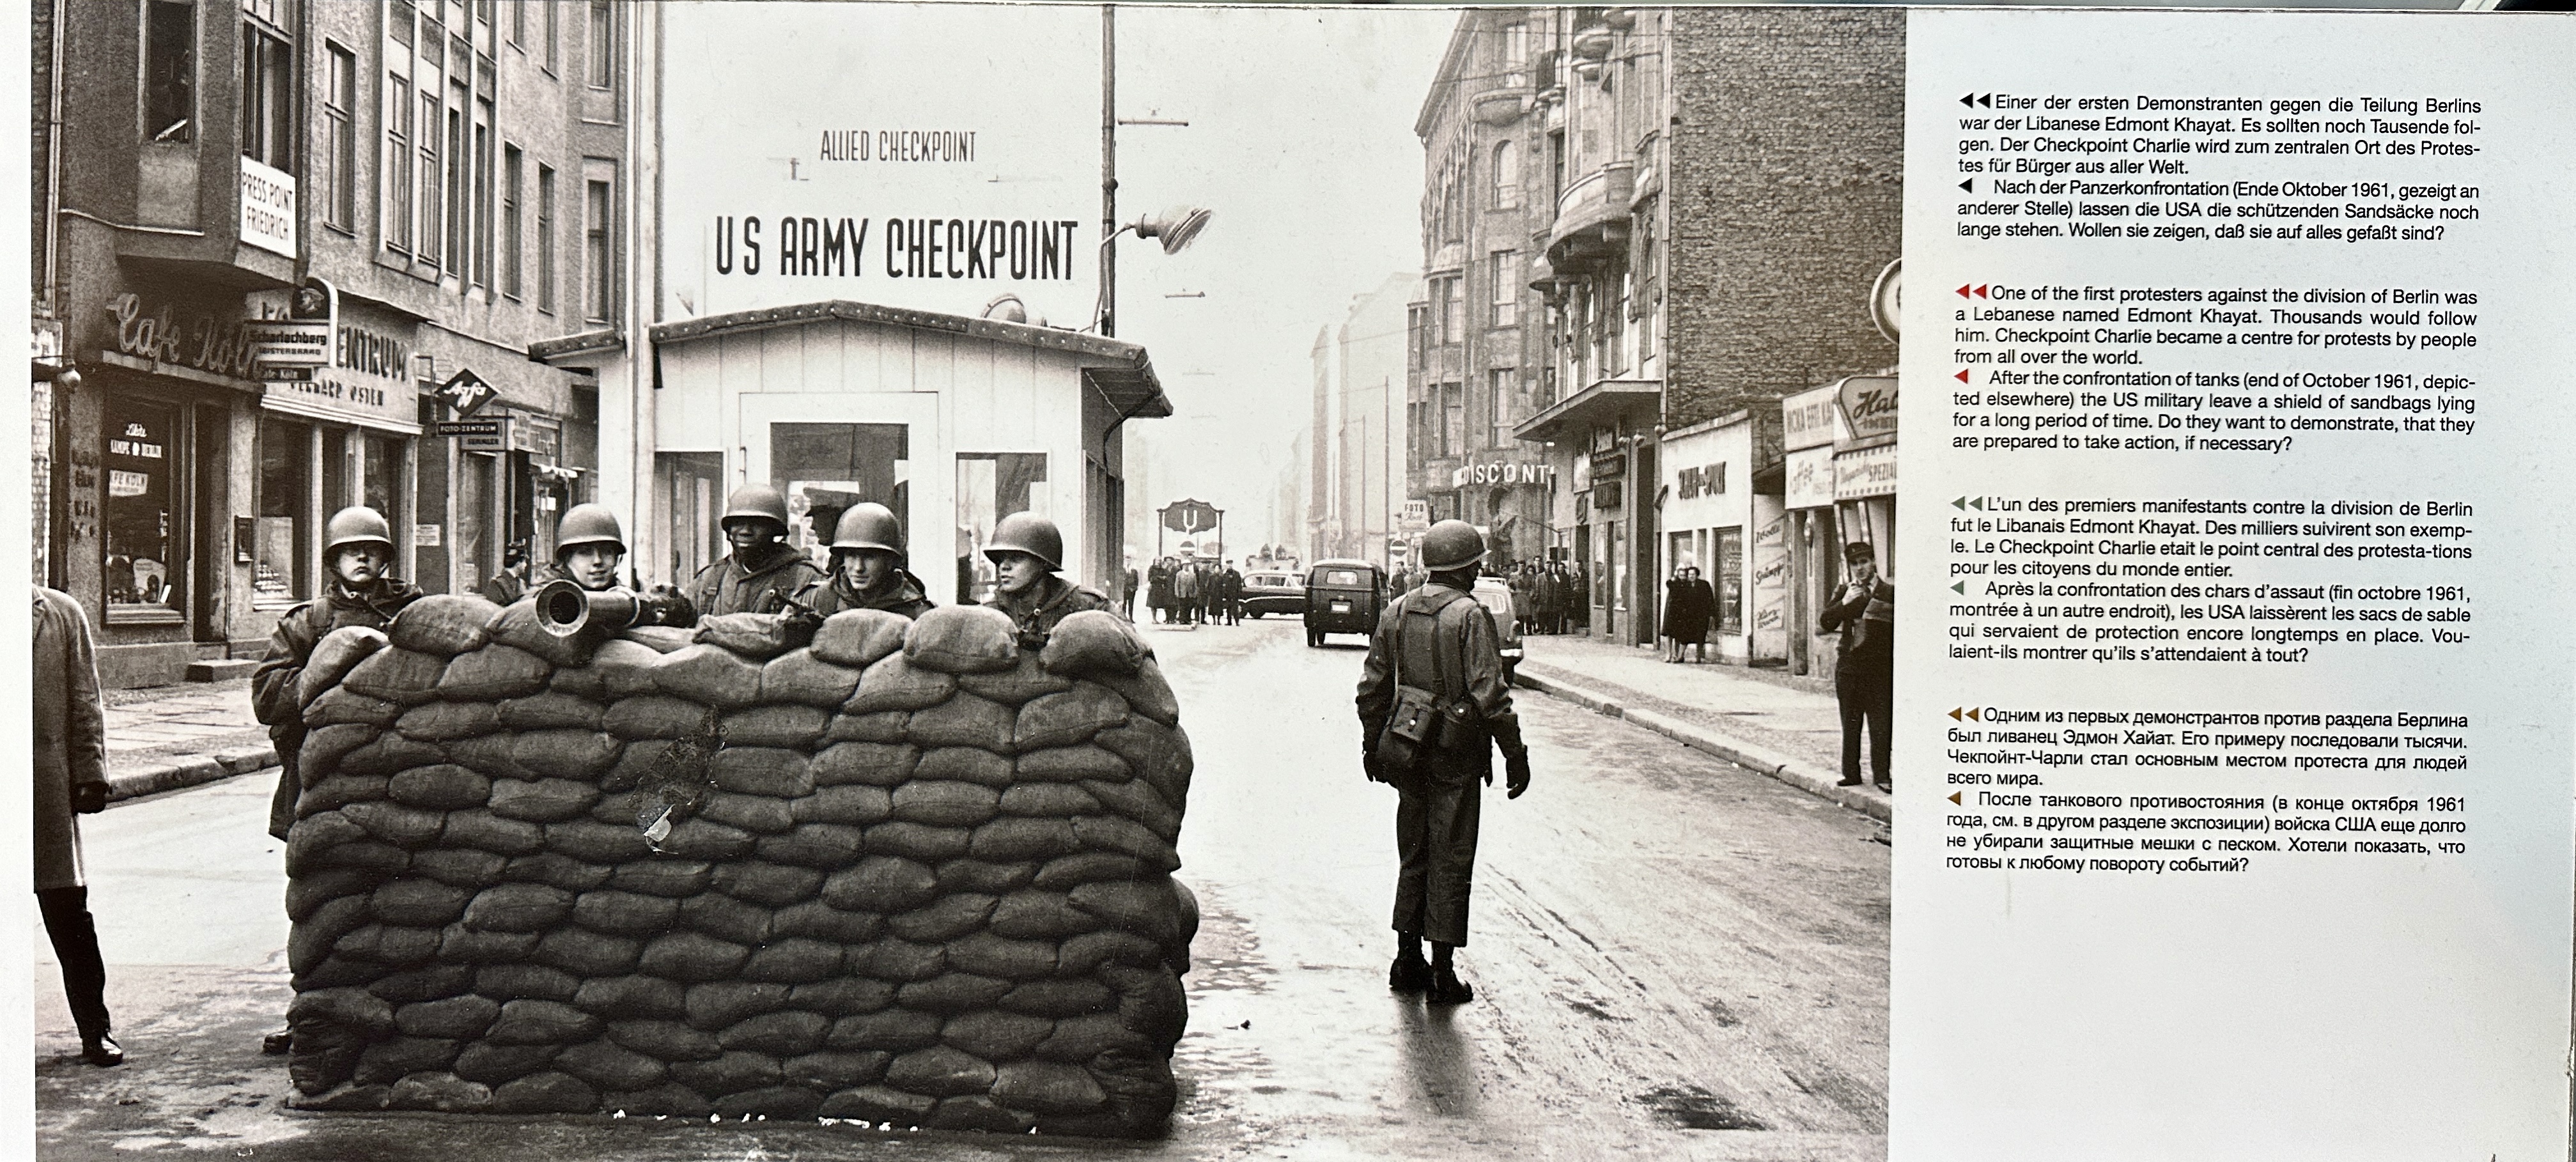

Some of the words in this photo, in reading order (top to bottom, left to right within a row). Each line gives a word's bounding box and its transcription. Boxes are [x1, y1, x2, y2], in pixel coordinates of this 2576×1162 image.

[1996, 94, 2038, 109] Einer
[2044, 95, 2072, 109] der
[2079, 96, 2129, 110] ersten
[2138, 96, 2262, 111] Demonstranten
[2270, 100, 2321, 115] gegen
[2329, 97, 2354, 112] die
[2361, 97, 2417, 116] Teilung
[2426, 98, 2481, 113] Berlins
[1959, 119, 1990, 130] war
[1994, 115, 2022, 130] der
[2026, 116, 2100, 131] Libanese
[2106, 116, 2169, 132] Edmont
[2175, 117, 2235, 136] Khayat.
[2242, 118, 2262, 132] Es
[2266, 118, 2320, 132] sollten
[2325, 118, 2365, 133] noch
[2370, 119, 2449, 134] Tausende
[2454, 120, 2481, 134] fol-
[820, 130, 869, 161] ALLIED
[879, 131, 976, 162] CHECKPOINT
[1959, 140, 1994, 155] gen.
[2001, 137, 2029, 151] Der
[2034, 137, 2129, 155] Checkpoint
[2133, 138, 2190, 153] Charlie
[2195, 139, 2230, 153] wird
[2235, 143, 2269, 153] zum
[2274, 139, 2349, 155] zentralen
[2355, 140, 2380, 155] Ort
[2386, 141, 2415, 155] des
[2421, 141, 2480, 155] Protes-
[1958, 159, 1983, 173] tes
[1988, 158, 2011, 173] für
[2016, 159, 2072, 176] Bürger
[2076, 162, 2105, 173] aus
[2110, 159, 2145, 174] aller
[2148, 159, 2189, 174] Welt.
[242, 172, 267, 203] PRESS
[270, 183, 292, 213] POINT
[247, 205, 289, 242] FRIEDRICH
[716, 216, 760, 275] US
[780, 216, 869, 276] ARMY
[887, 218, 1078, 280] CHECKPOINT
[1992, 285, 2026, 300] One
[2031, 286, 2048, 300] of
[2052, 286, 2079, 300] the
[2083, 286, 2114, 300] first
[2120, 288, 2203, 304] protesters
[2208, 288, 2268, 306] against
[2272, 288, 2299, 302] the
[2304, 288, 2365, 303] division
[2371, 289, 2387, 303] of
[2393, 289, 2439, 304] Berlin
[2444, 293, 2477, 304] was
[1955, 310, 1966, 321] a
[1974, 307, 2055, 321] Lebanese
[2063, 307, 2119, 322] named
[2128, 308, 2192, 323] Edmont
[2200, 308, 2262, 327] Khayat.
[2270, 309, 2362, 324] Thousands
[2370, 311, 2419, 325] would
[2428, 311, 2478, 325] follow
[1955, 328, 1989, 342] him.
[1995, 328, 2090, 346] Checkpoint
[2095, 329, 2152, 343] Charlie
[2157, 329, 2223, 344] became
[2227, 334, 2237, 344] a
[2242, 331, 2293, 345] centre
[2297, 330, 2320, 345] for
[2324, 332, 2391, 349] protests
[2396, 332, 2417, 350] by
[2421, 332, 2477, 350] people
[1954, 349, 1992, 363] from
[1998, 349, 2015, 363] all
[2021, 353, 2058, 364] over
[2061, 350, 2088, 364] the
[2093, 350, 2143, 364] world.
[444, 380, 486, 408] Agfa
[2028, 497, 2059, 511] des
[2065, 498, 2136, 515] premiers
[2143, 499, 2247, 513] manifestants
[2253, 500, 2305, 515] contre
[2311, 500, 2325, 515] la
[2331, 500, 2393, 515] division
[2400, 501, 2420, 516] de
[2427, 501, 2472, 516] Berlin
[1183, 509, 1197, 530] U
[1950, 518, 1973, 532] fut
[1978, 518, 1992, 532] le
[1997, 518, 2065, 532] Libanais
[2070, 519, 2134, 534] Edmont
[2139, 519, 2200, 538] Khayat.
[2205, 520, 2237, 535] Des
[2242, 520, 2299, 536] milliers
[2302, 522, 2371, 536] suivirent
[2375, 525, 2405, 536] son
[2410, 526, 2472, 541] exemp-
[1951, 563, 1989, 577] pour
[1994, 560, 2017, 575] les
[2022, 561, 2091, 578] citoyens
[2096, 561, 2117, 575] du
[2123, 562, 2180, 576] monde
[2184, 562, 2233, 577] entier.
[1984, 707, 2040, 724] Одним
[2045, 711, 2063, 722] из
[2068, 712, 2129, 726] первых
[2132, 713, 2259, 727] демонстрантов
[2265, 715, 2320, 729] против
[2325, 715, 2392, 729] раздела
[2398, 712, 2468, 731] Берлина
[1948, 727, 1982, 742] был
[1987, 732, 2058, 746] ливанец
[2063, 729, 2118, 747] Эдмон
[2123, 730, 2175, 745] Хайат.
[2182, 731, 2209, 745] Его
[2215, 734, 2286, 750] примеру
[2291, 736, 2398, 750] последовали
[2404, 737, 2467, 748] тысячи.
[1948, 749, 2083, 768] Чекпойнт-Чарли
[2091, 754, 2128, 765] стал
[2136, 755, 2218, 766] основным
[2226, 756, 2286, 767] местом
[2295, 757, 2368, 771] протеста
[2375, 757, 2405, 771] для
[2413, 755, 2467, 771] людей
[1948, 773, 1992, 784] всего
[1997, 774, 2043, 789] мира.
